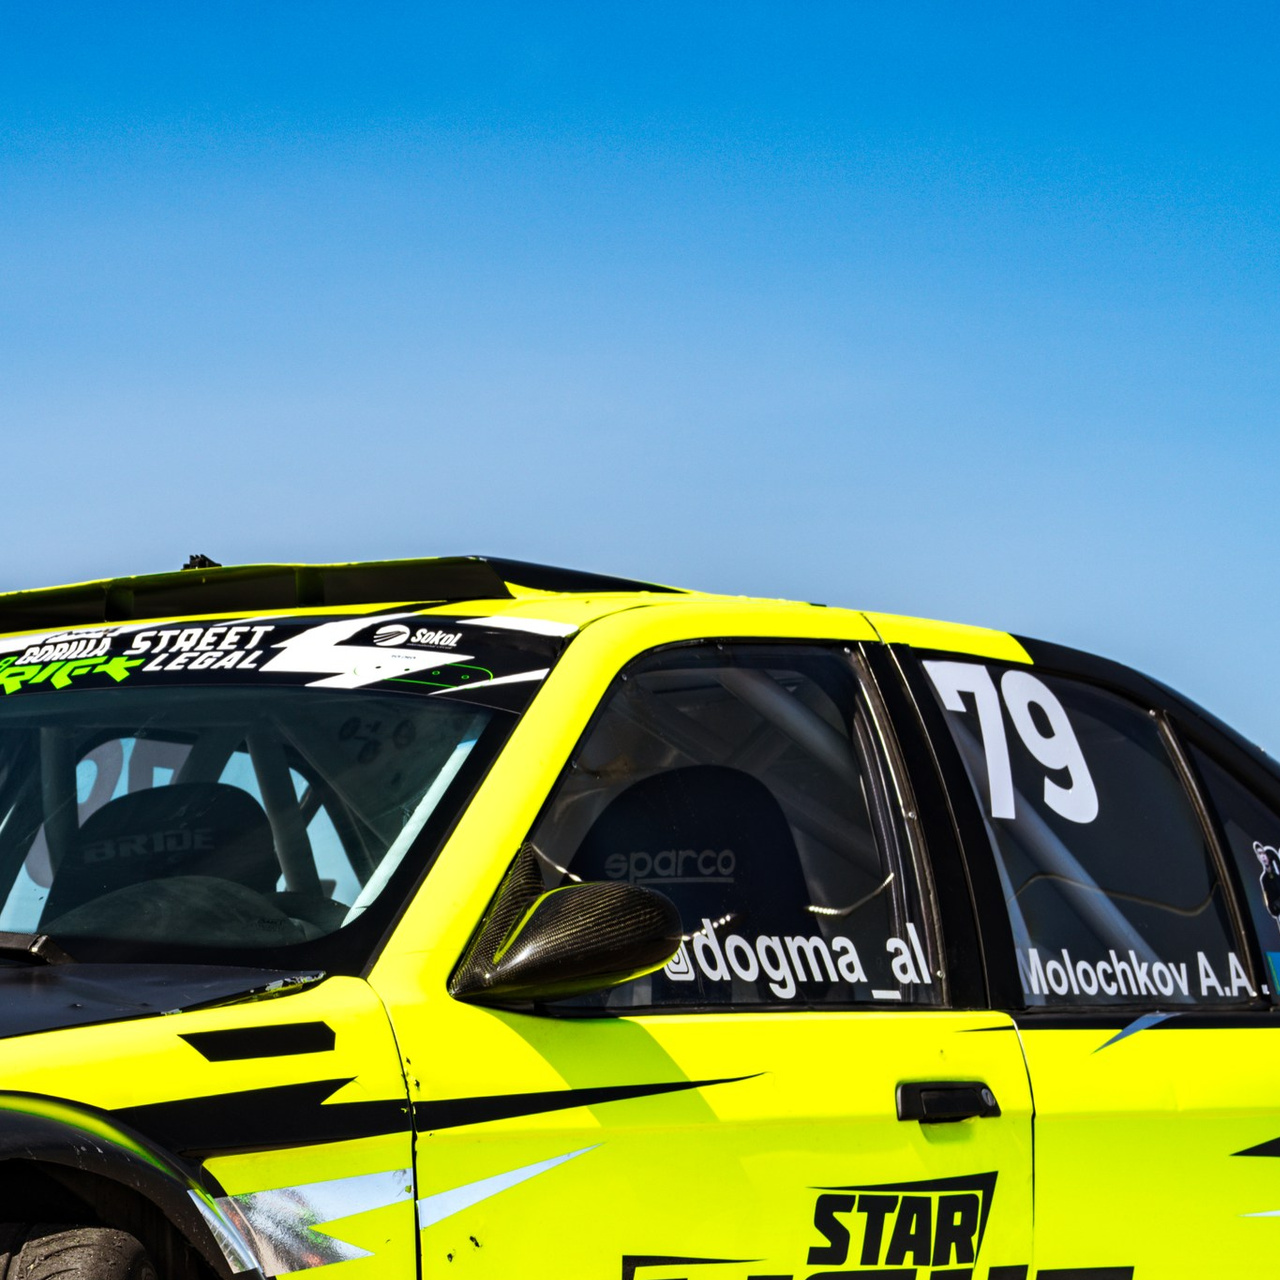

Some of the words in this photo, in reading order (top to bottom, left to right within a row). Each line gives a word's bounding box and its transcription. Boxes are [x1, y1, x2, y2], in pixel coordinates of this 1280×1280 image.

[14, 637, 112, 666] GORILLA
[122, 625, 276, 656] STREET
[141, 650, 264, 672] LEGAL
[922, 659, 1100, 825] 79
[83, 828, 216, 864] BRIDE
[604, 849, 737, 884] sparco
[1015, 948, 1189, 996] Molochkov
[807, 1193, 981, 1267] STAR
